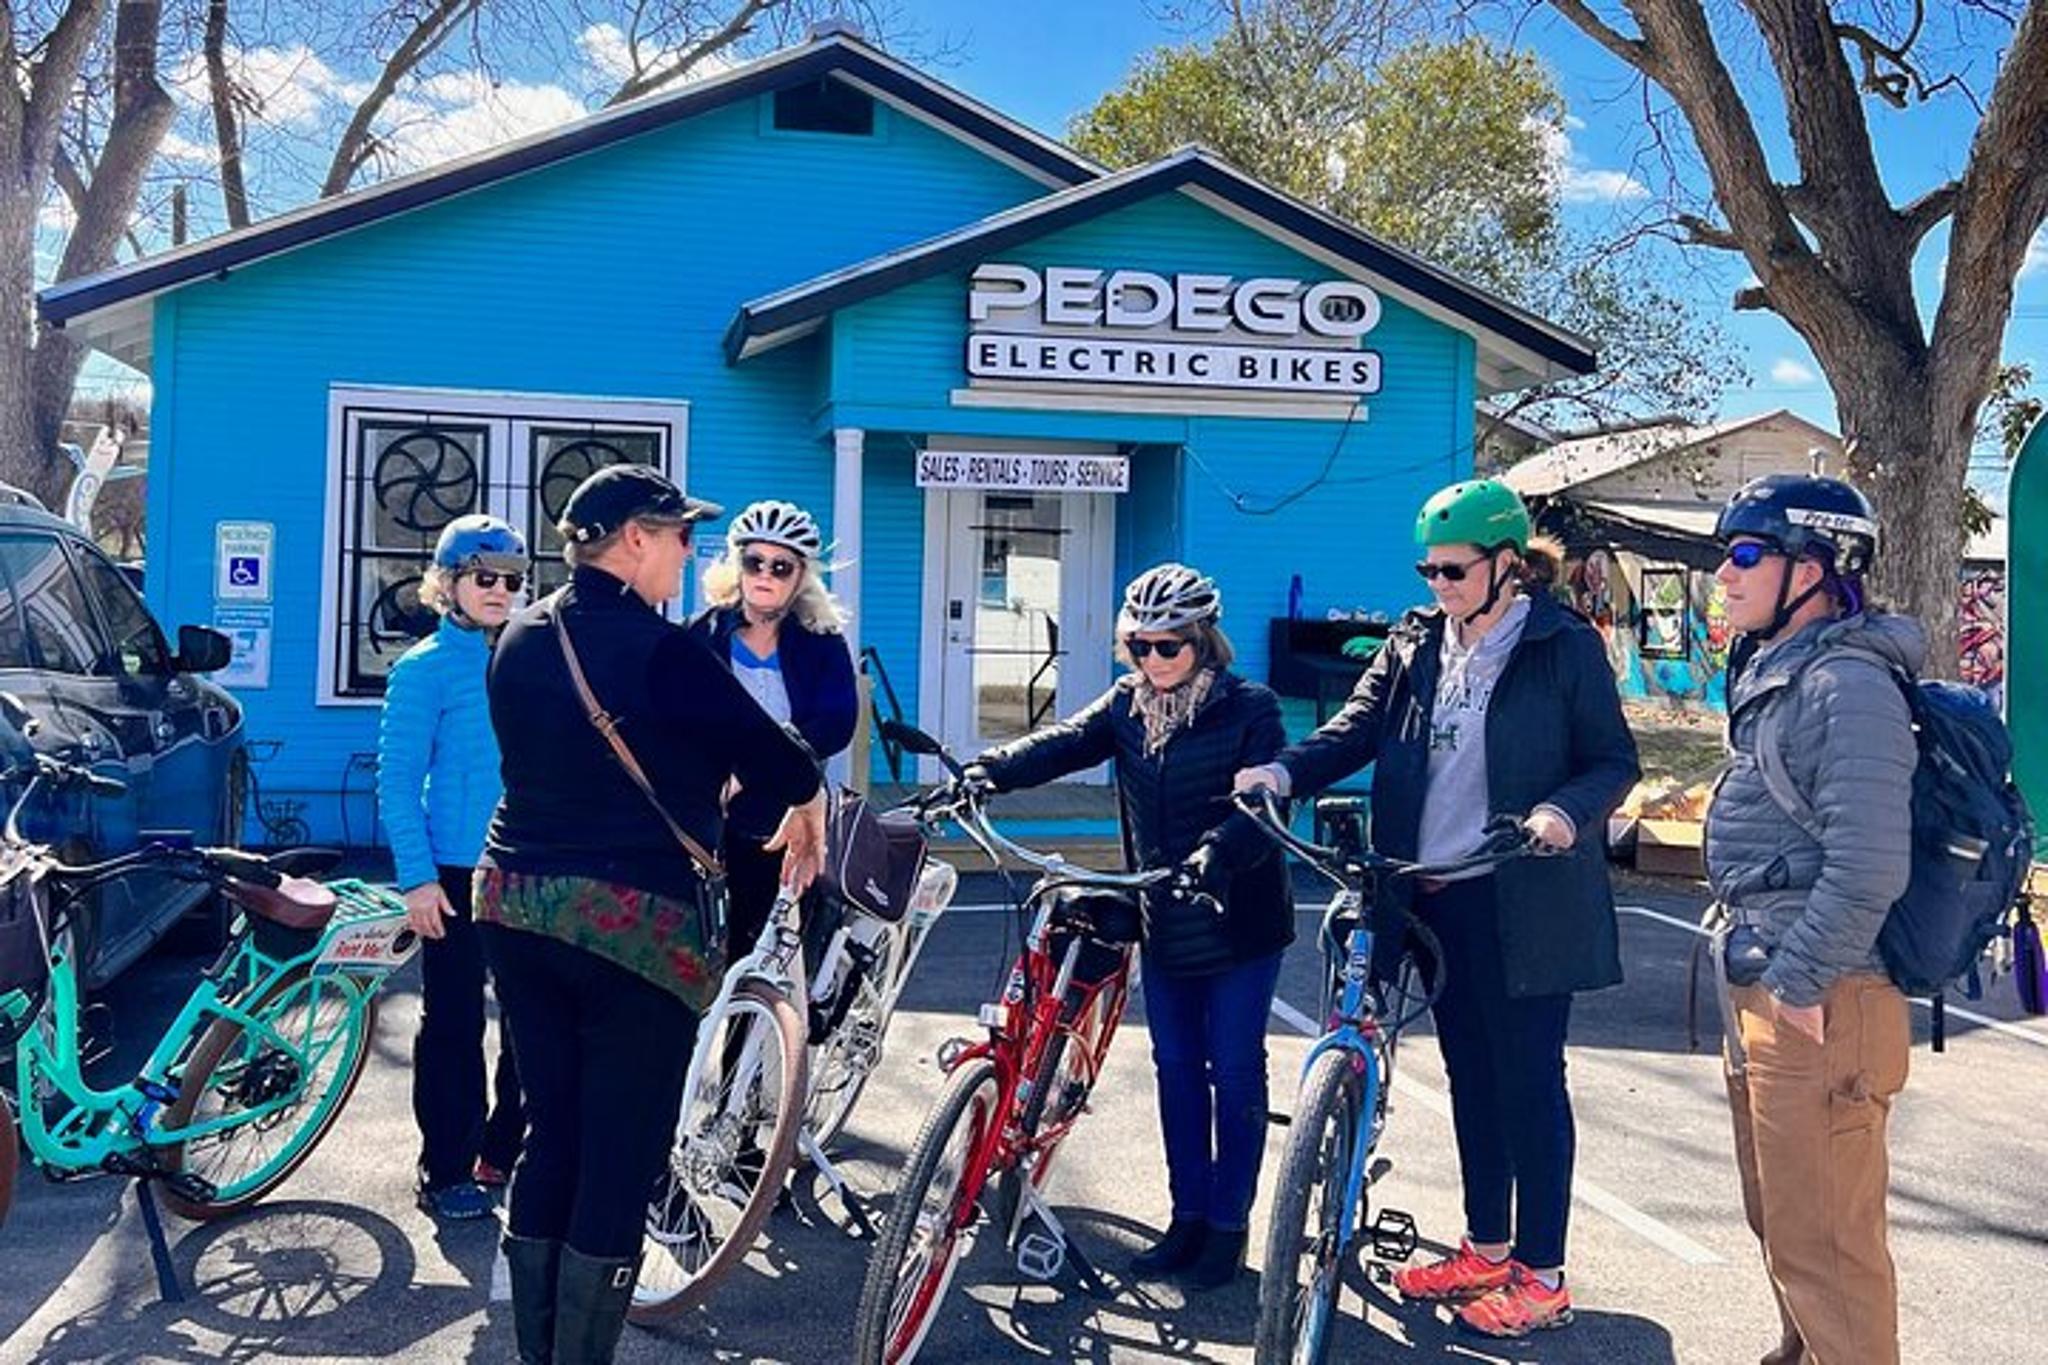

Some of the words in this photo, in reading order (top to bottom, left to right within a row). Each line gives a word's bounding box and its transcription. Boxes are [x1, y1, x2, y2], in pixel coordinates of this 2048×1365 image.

[970, 263, 1381, 337] PEDEGO
[979, 343, 1209, 376] ELECTRIC
[1239, 357, 1369, 384] BIKES
[920, 455, 959, 482] SALES
[967, 457, 1020, 484] RENTALS
[1030, 459, 1069, 486] TOURS
[1077, 460, 1124, 487] SERVICE
